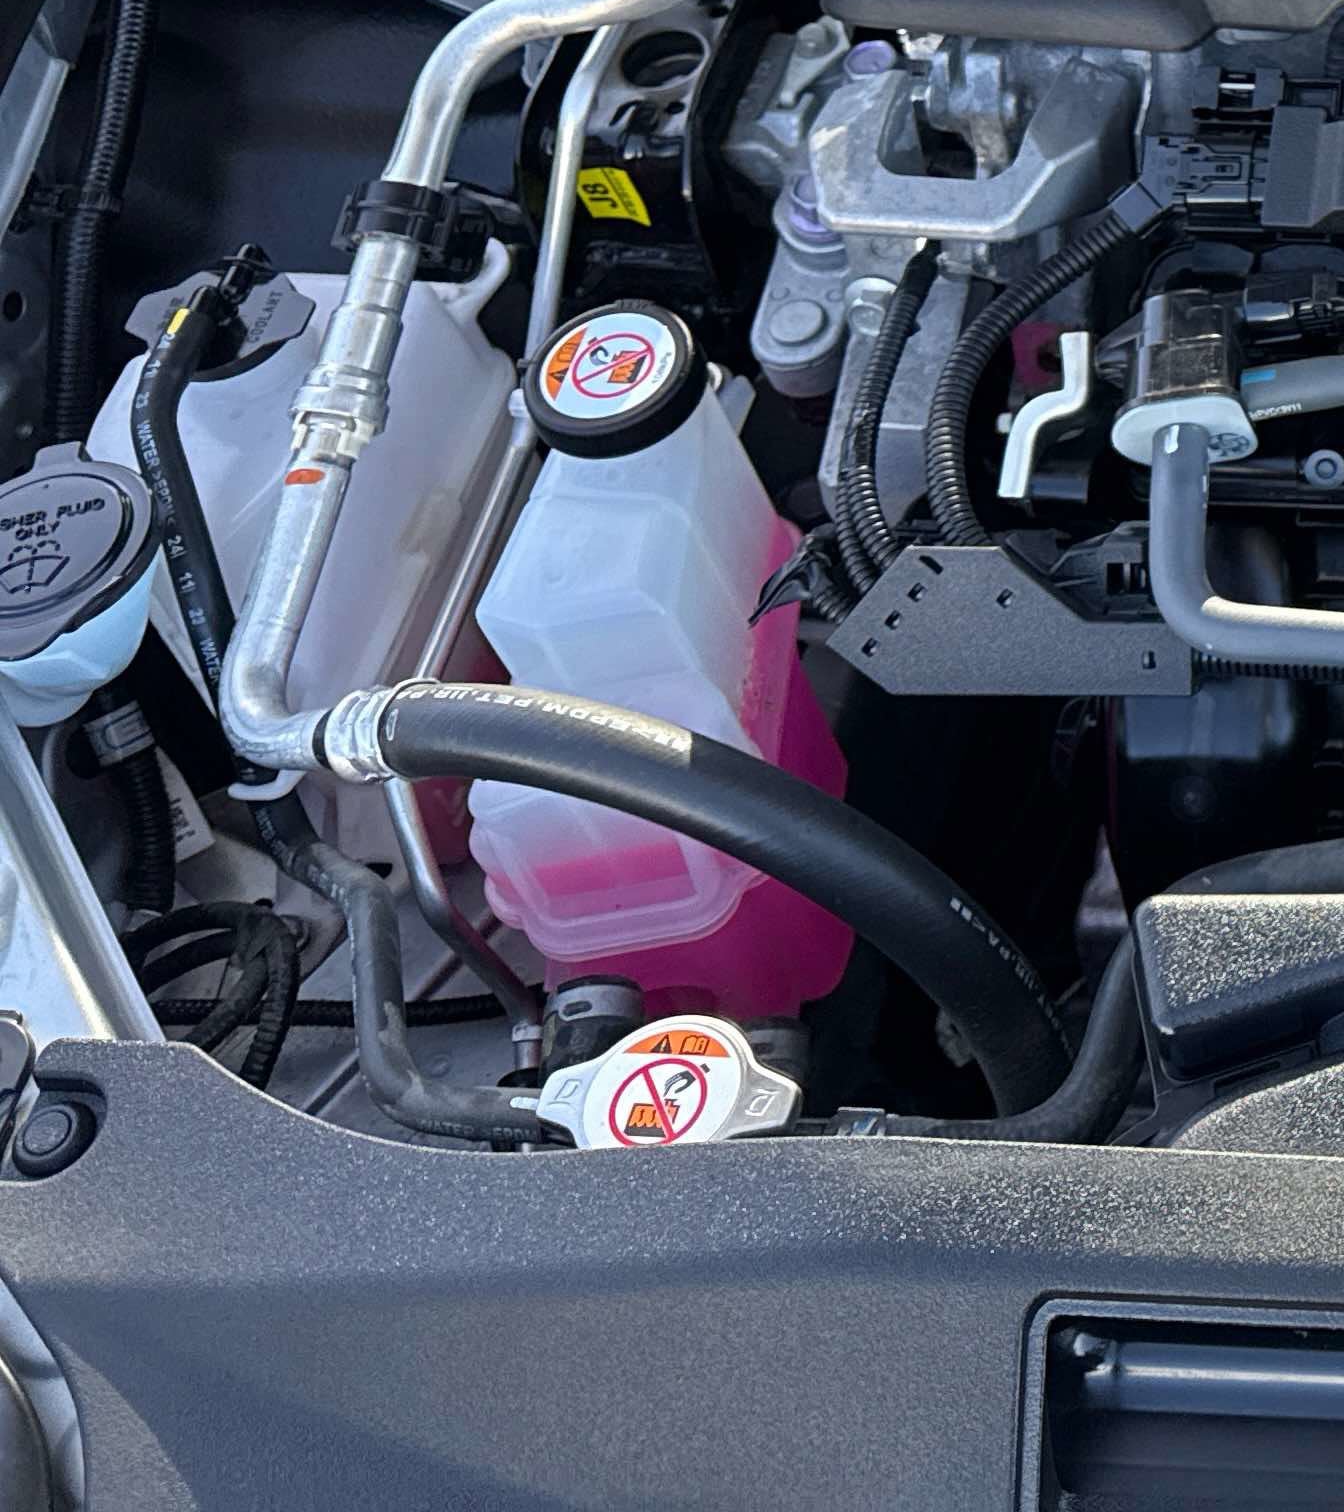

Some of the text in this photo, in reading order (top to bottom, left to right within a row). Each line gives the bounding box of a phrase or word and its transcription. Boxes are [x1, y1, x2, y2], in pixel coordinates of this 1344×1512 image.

[249, 290, 284, 344] COOLANT
[137, 419, 160, 470] WATER
[56, 498, 106, 519] FLUID
[15, 520, 61, 541] ONLY
